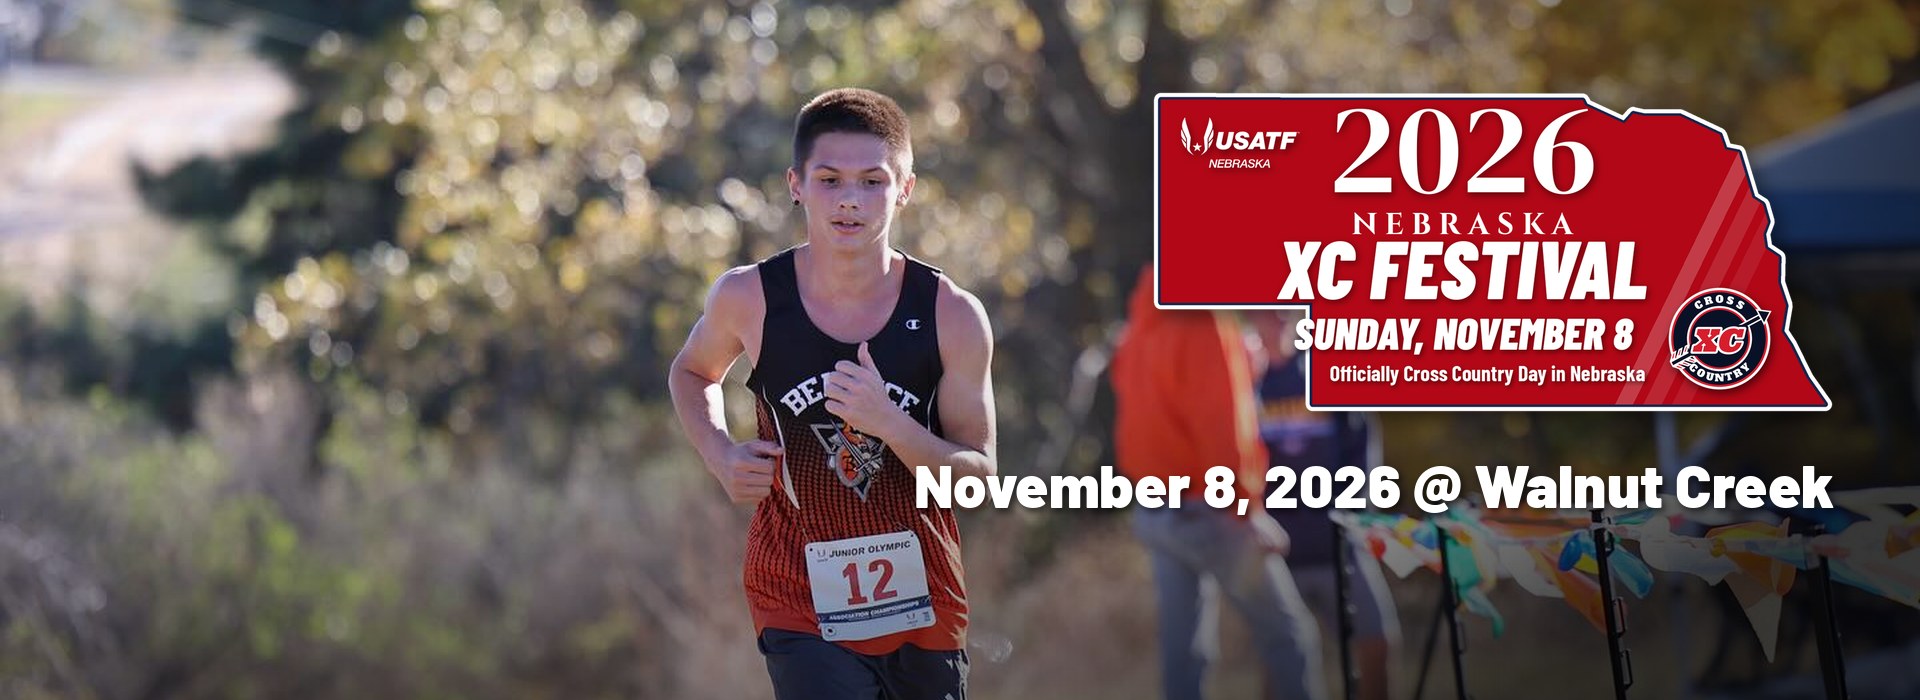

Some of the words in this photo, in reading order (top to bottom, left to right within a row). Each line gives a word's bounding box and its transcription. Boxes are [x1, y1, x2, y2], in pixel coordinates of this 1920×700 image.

[829, 547, 865, 558] JUNIOR
[868, 540, 911, 554] OLYMPIC
[842, 558, 898, 606] 12
